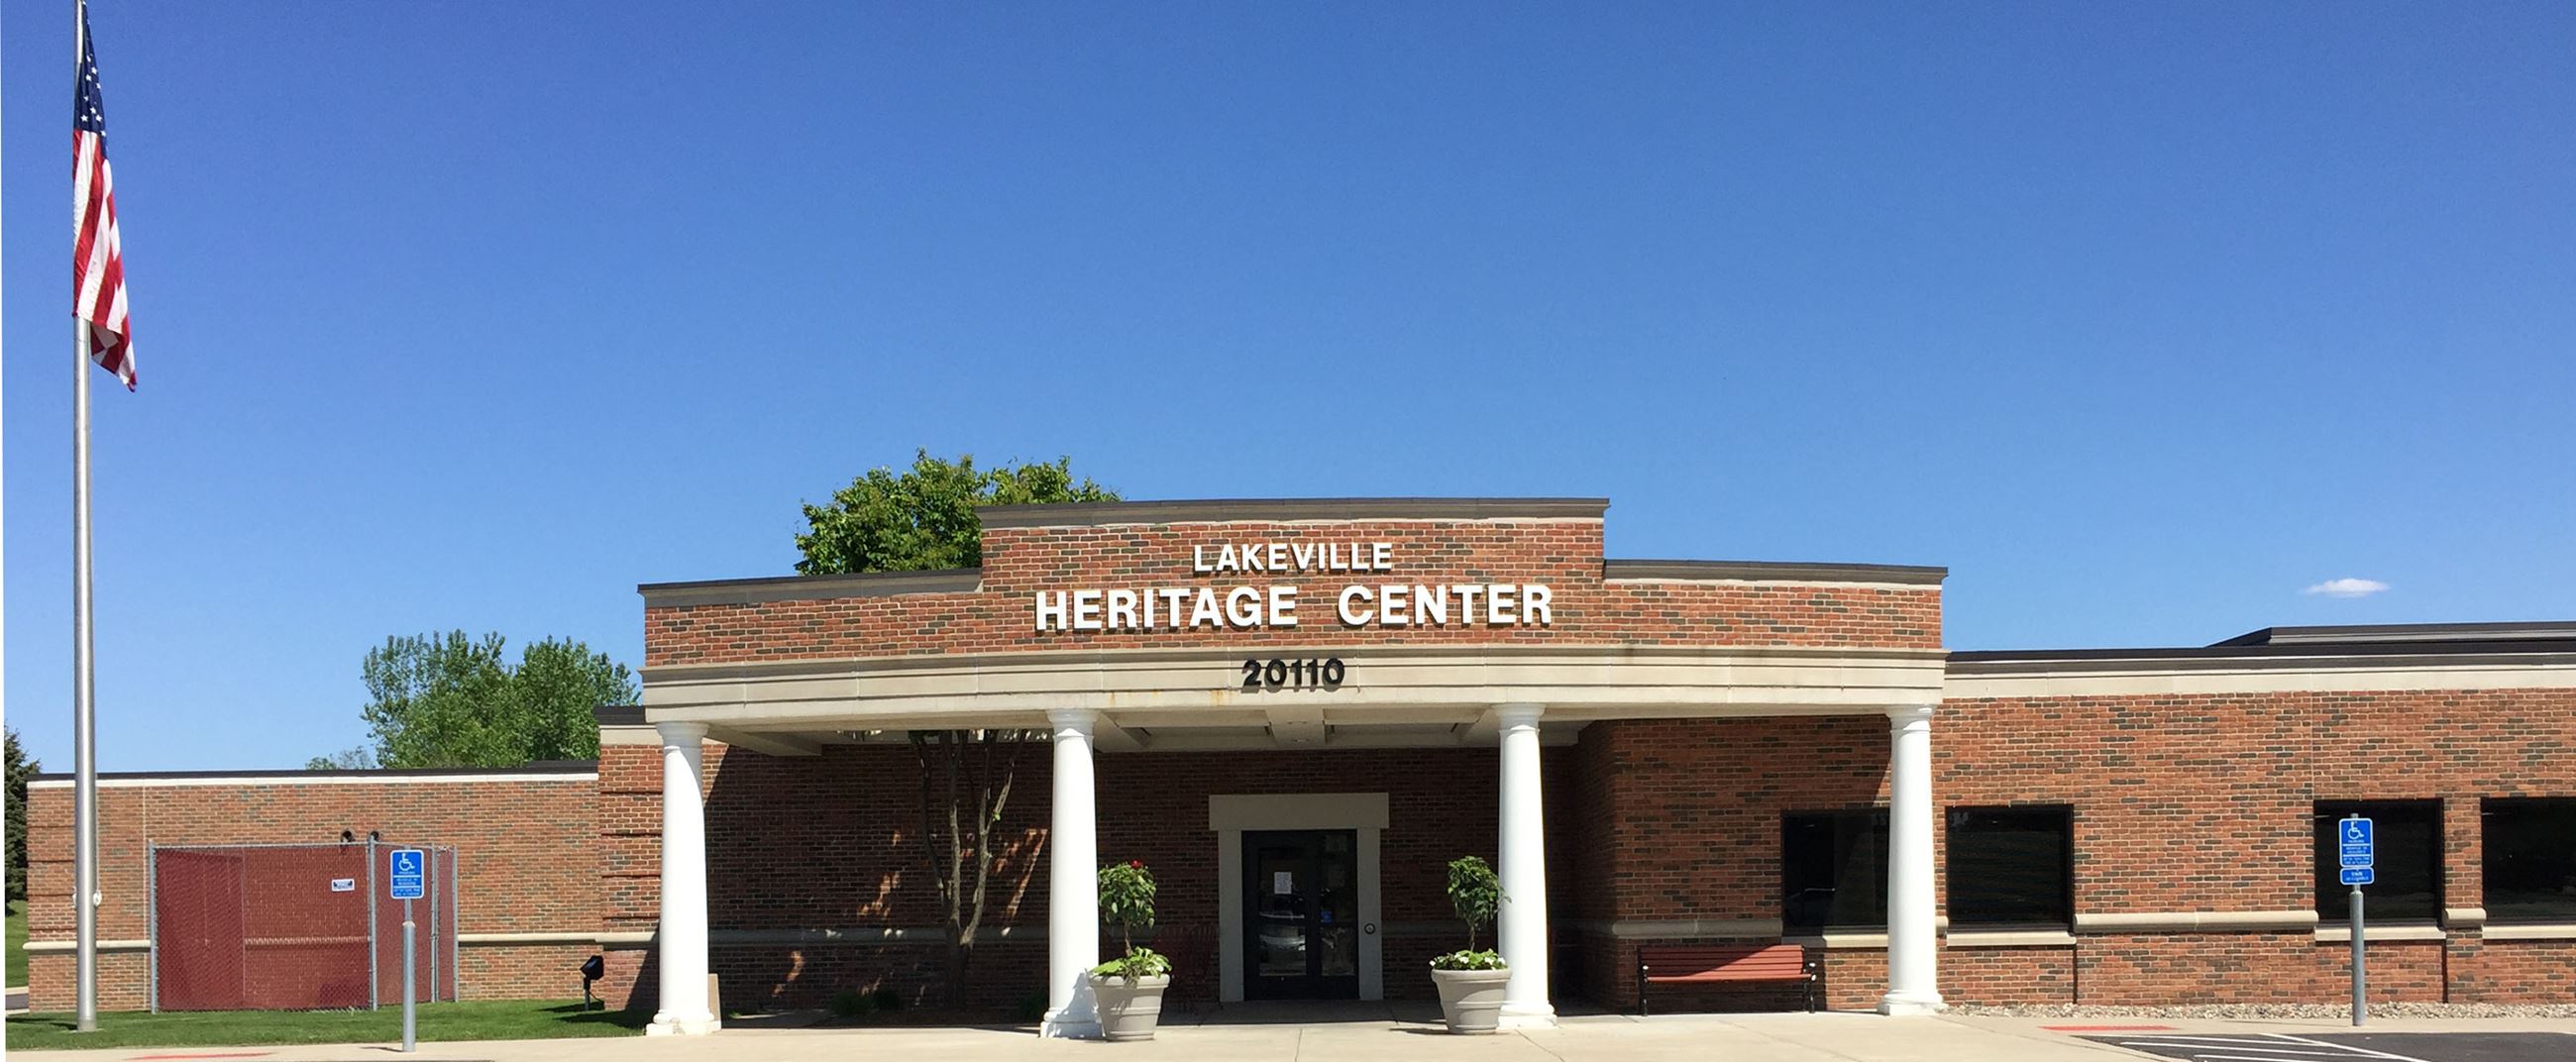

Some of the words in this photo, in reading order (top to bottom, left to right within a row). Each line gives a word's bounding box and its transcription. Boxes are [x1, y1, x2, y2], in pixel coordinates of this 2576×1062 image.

[1193, 542, 1393, 573] LAKEVILLE
[1034, 585, 1299, 632] HERITAGE
[1338, 584, 1553, 627] CENTER
[1241, 658, 1345, 689] 20110
